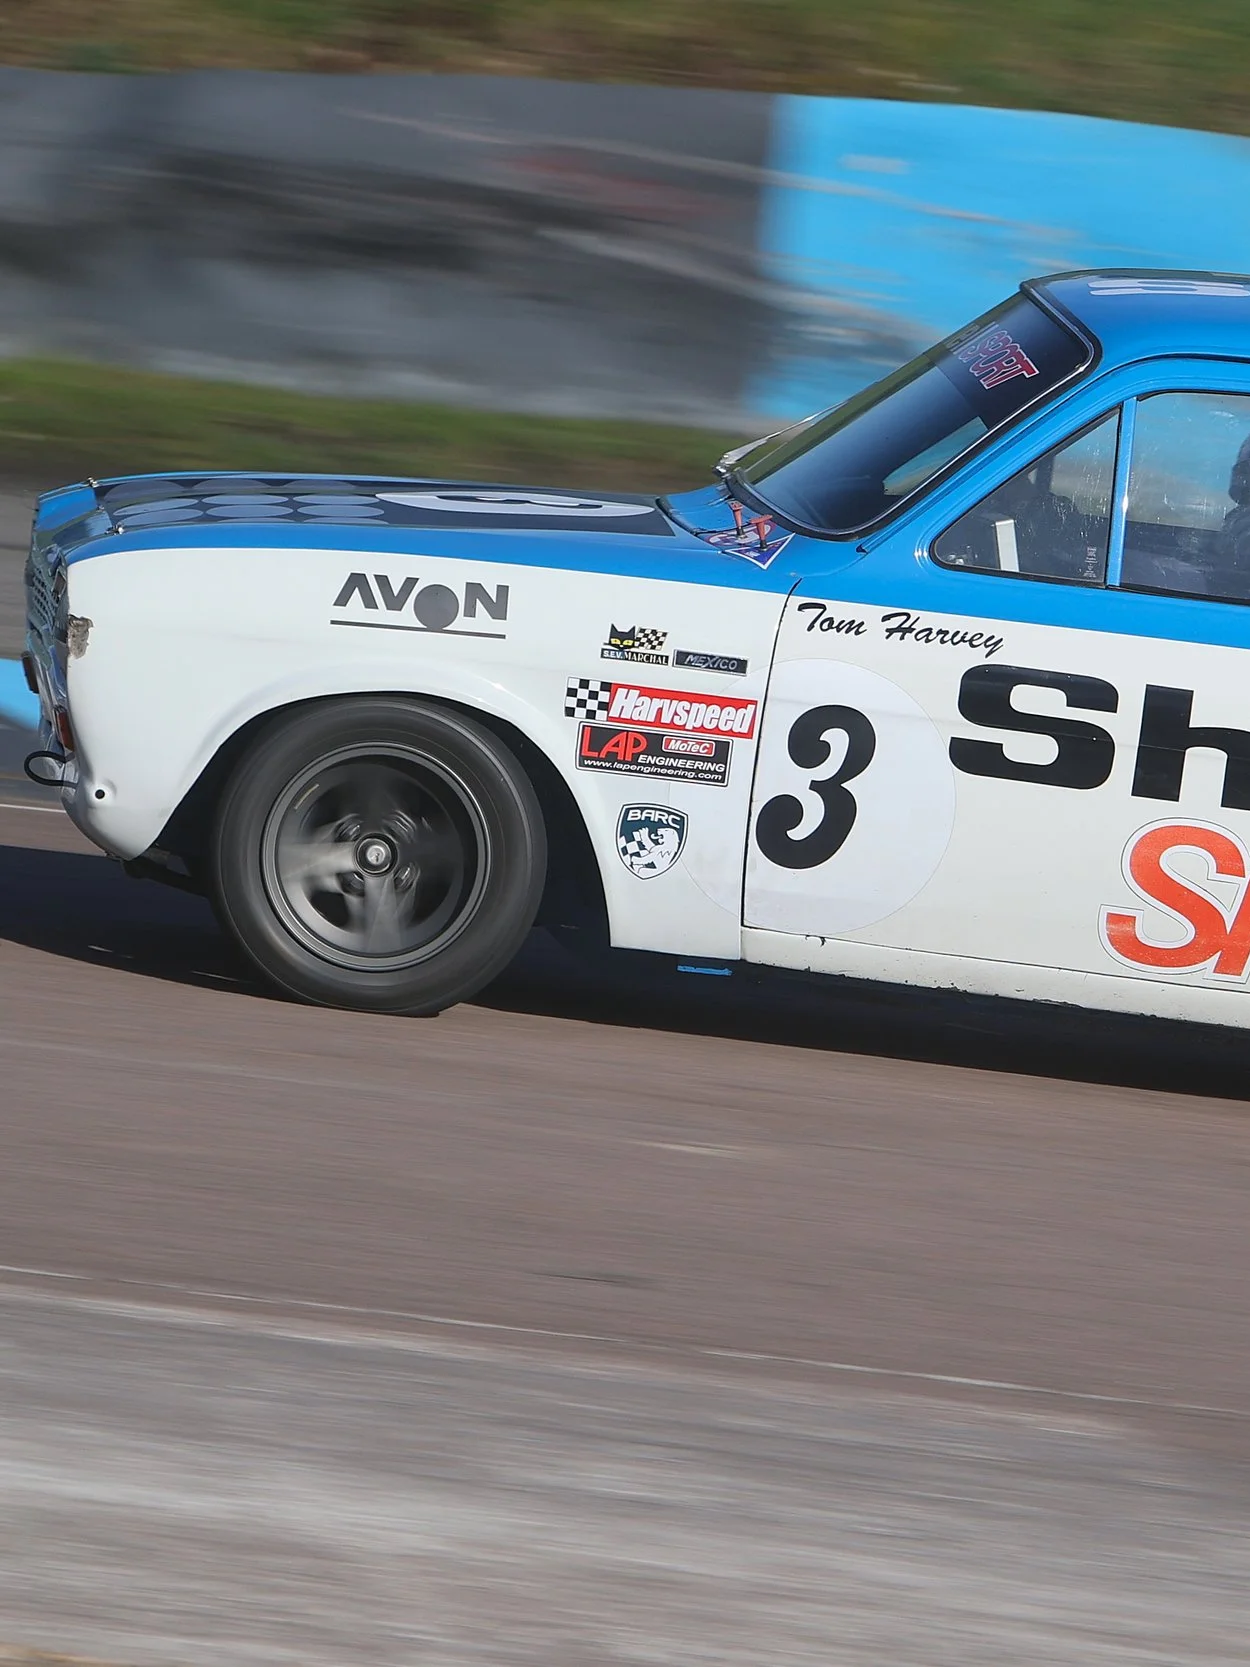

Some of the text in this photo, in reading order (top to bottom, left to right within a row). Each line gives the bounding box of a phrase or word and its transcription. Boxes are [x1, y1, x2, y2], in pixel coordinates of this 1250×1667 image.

[959, 330, 1039, 389] SPORT
[333, 572, 509, 630] AVON
[797, 602, 1004, 658] Tom Harvey
[603, 650, 668, 665] S.E.V. MARCHAL
[684, 654, 738, 671] MEXICO
[609, 687, 756, 734] Harvspeed
[581, 726, 648, 761] LAP
[668, 739, 710, 754] MoTeC
[584, 759, 723, 781] www.lapengineering.com
[637, 754, 725, 772] ENGINEERING
[756, 704, 876, 869] 3
[627, 809, 680, 829] BARC
